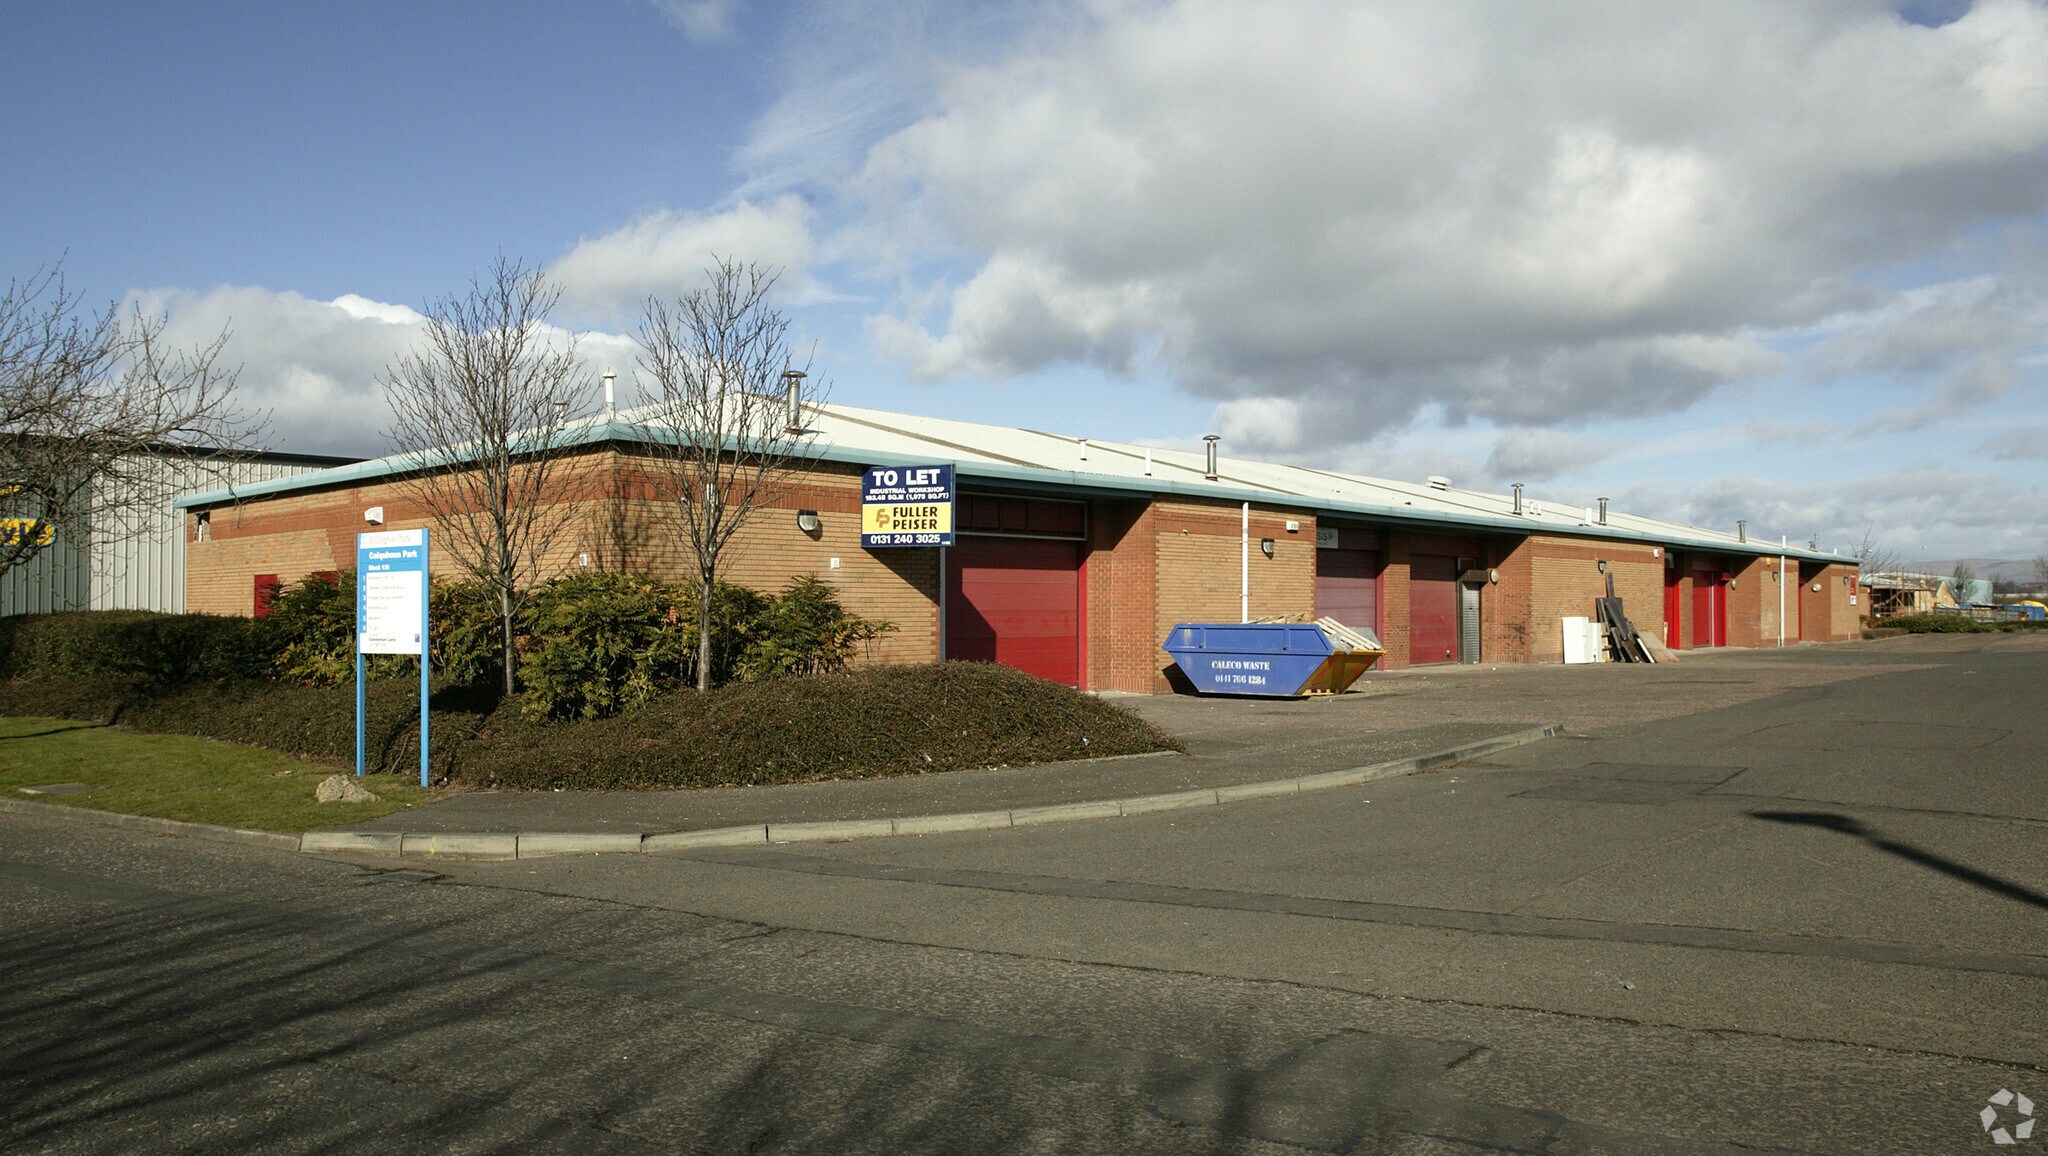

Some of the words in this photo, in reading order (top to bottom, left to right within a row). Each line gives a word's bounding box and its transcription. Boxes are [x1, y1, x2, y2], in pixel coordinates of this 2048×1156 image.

[872, 470, 898, 486] TO
[906, 469, 940, 485] LET
[893, 506, 938, 518] FULLER
[893, 519, 938, 530] PEISER
[870, 534, 891, 544] 0131
[894, 534, 913, 544] 240
[915, 534, 941, 543] 3025
[369, 551, 401, 560] Colquhoun
[402, 549, 418, 558] Park
[1212, 661, 1242, 669] CALECO
[1243, 661, 1270, 670] WASTE
[1215, 675, 1231, 683] 0141
[1248, 675, 1266, 684] 1284
